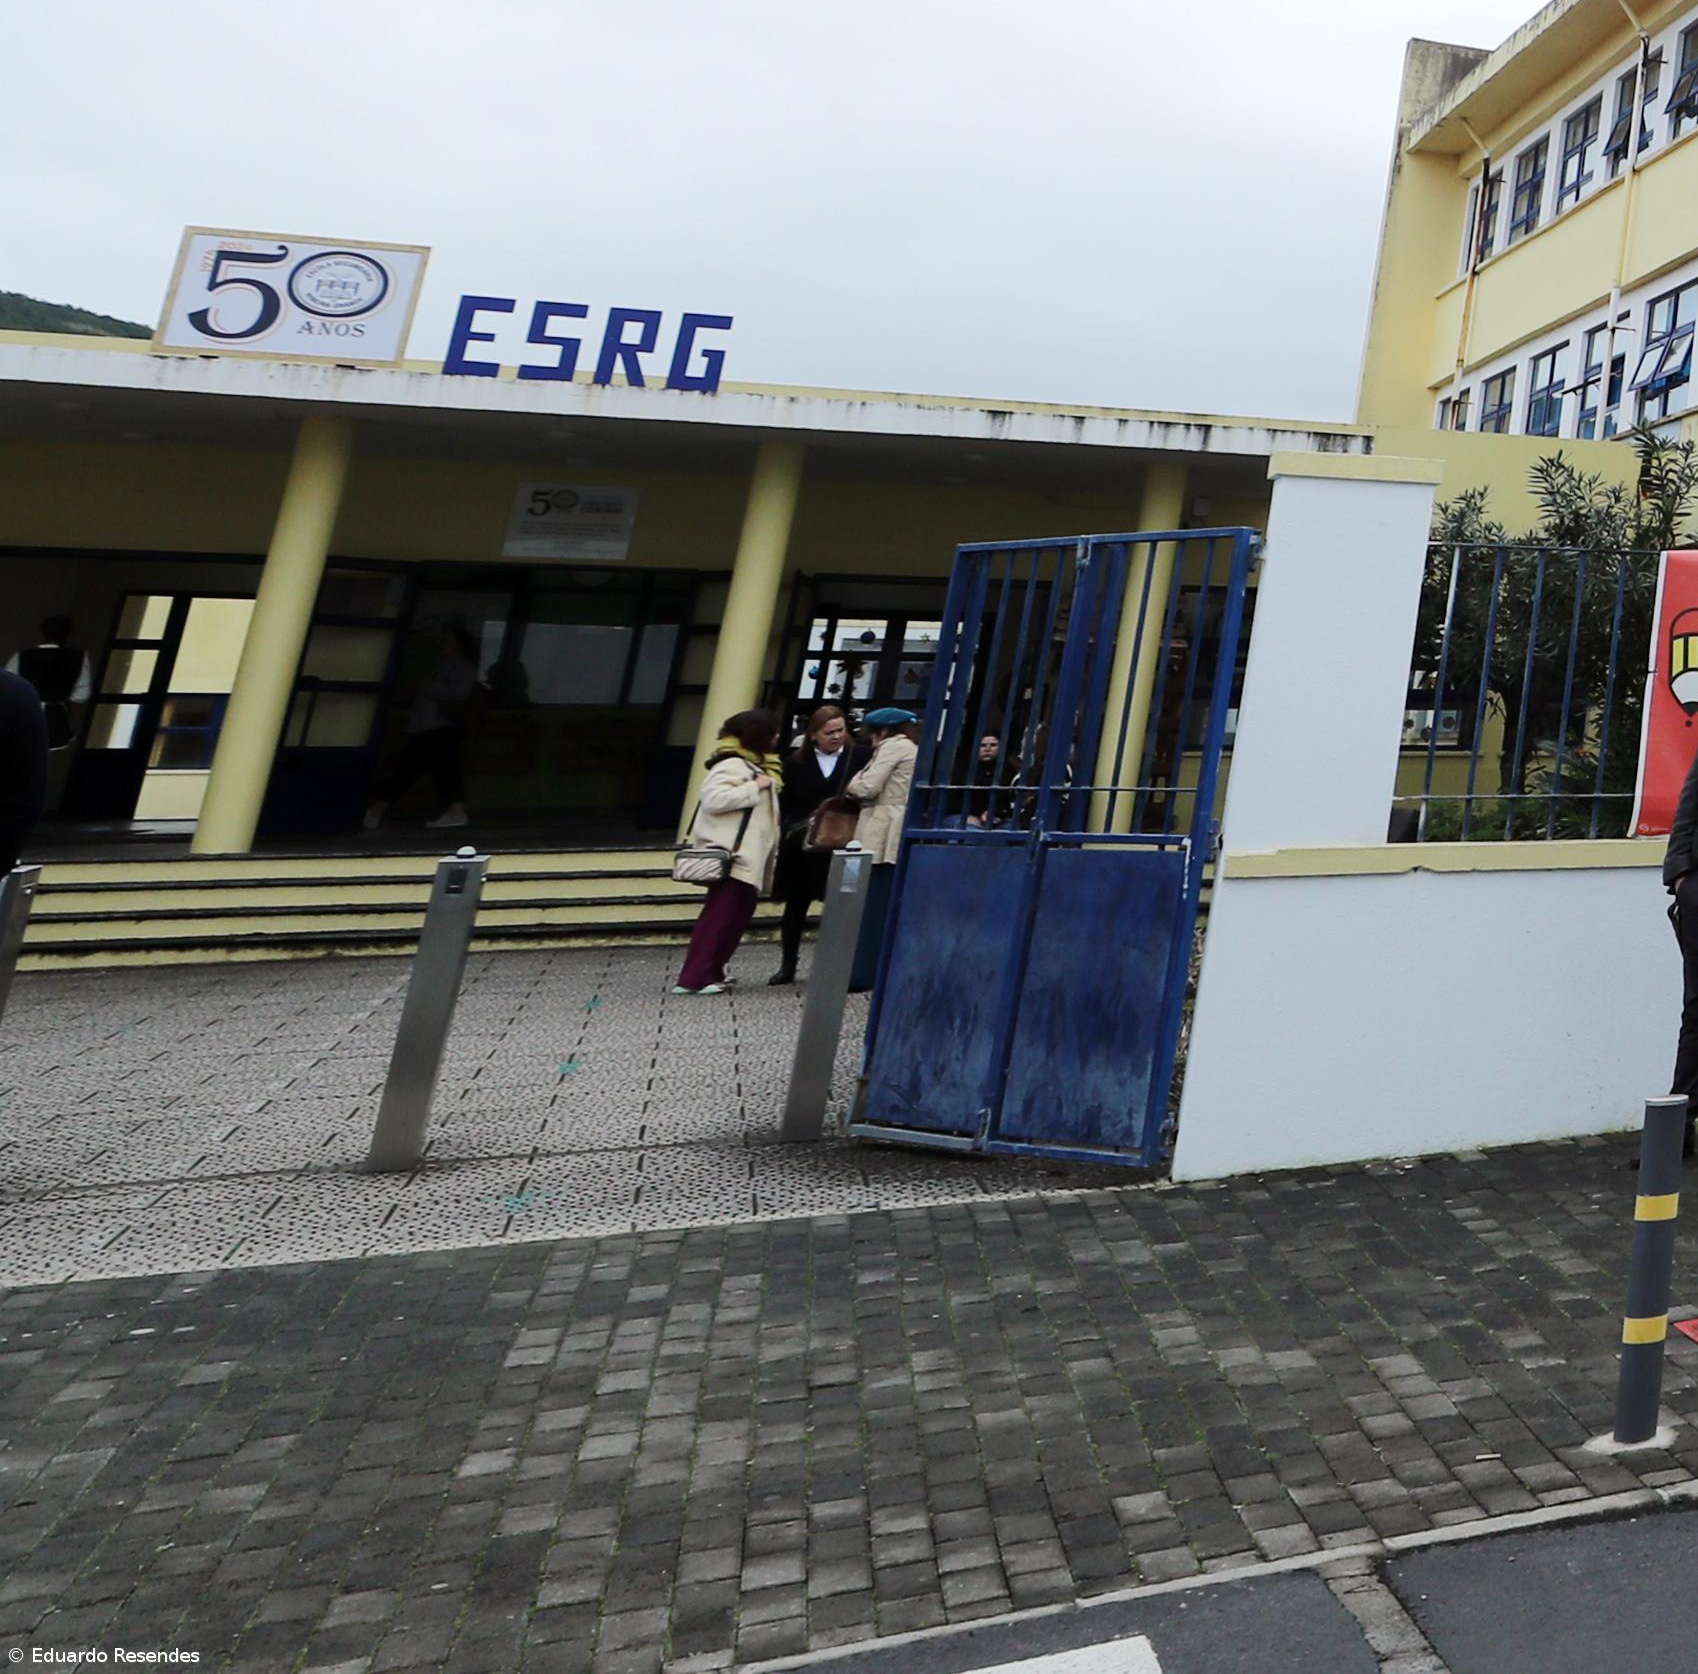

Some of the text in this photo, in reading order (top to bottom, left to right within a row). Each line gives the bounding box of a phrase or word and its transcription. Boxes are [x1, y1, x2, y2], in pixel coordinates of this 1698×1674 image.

[188, 245, 389, 339] 50
[297, 321, 365, 338] ANOS
[442, 294, 733, 396] ESRG
